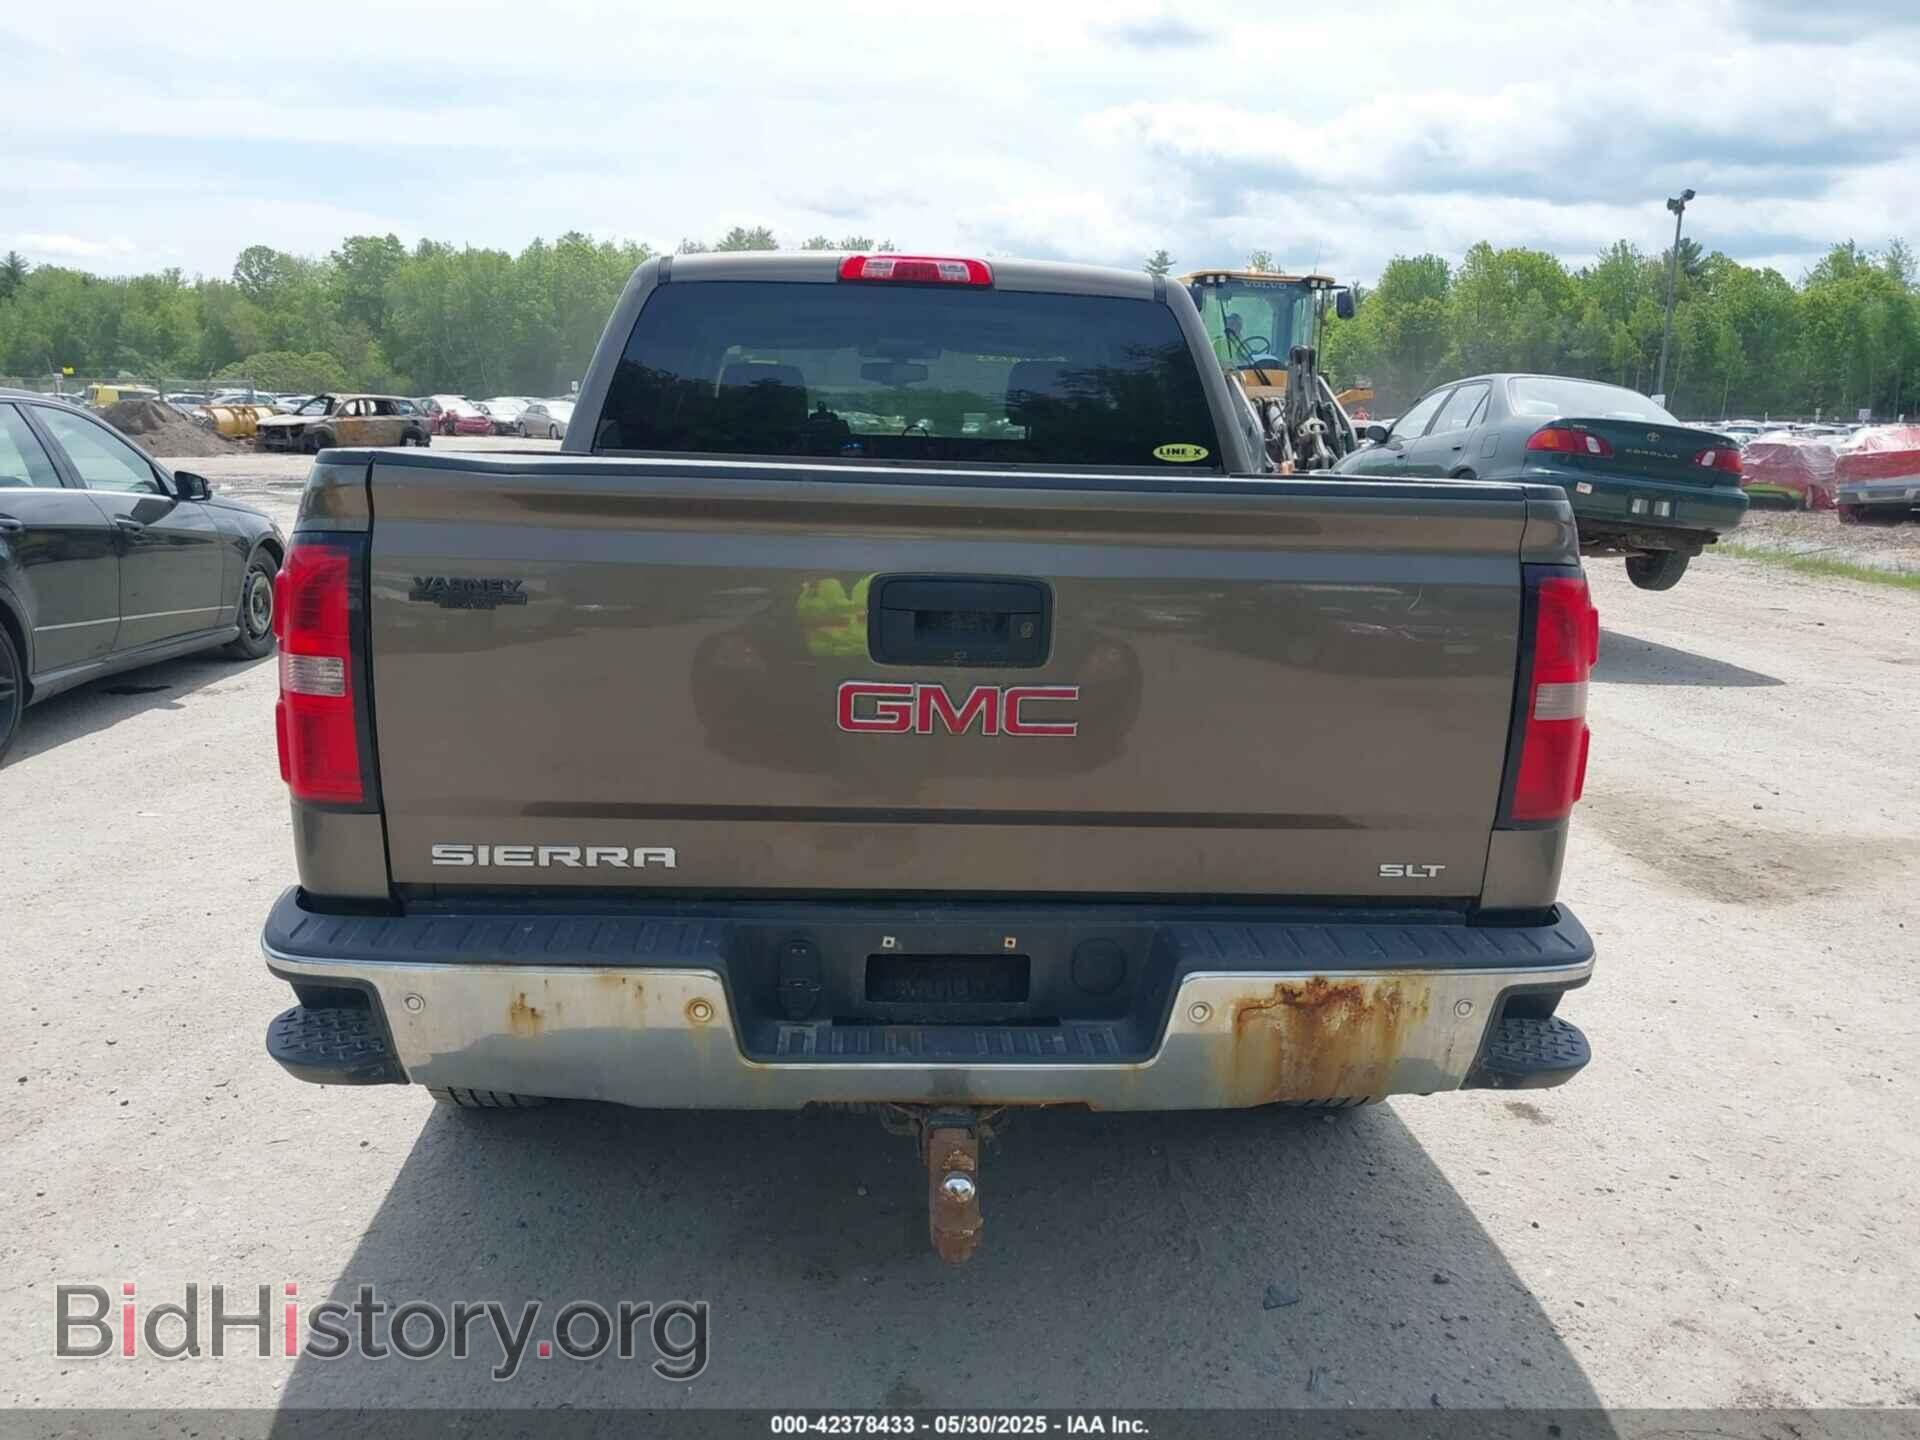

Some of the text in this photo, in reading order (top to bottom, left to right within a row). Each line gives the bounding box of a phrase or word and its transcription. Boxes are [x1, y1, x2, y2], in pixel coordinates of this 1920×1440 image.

[837, 680, 1080, 737] GMC
[431, 844, 677, 868] SIERRA
[1379, 864, 1446, 878] SLT
